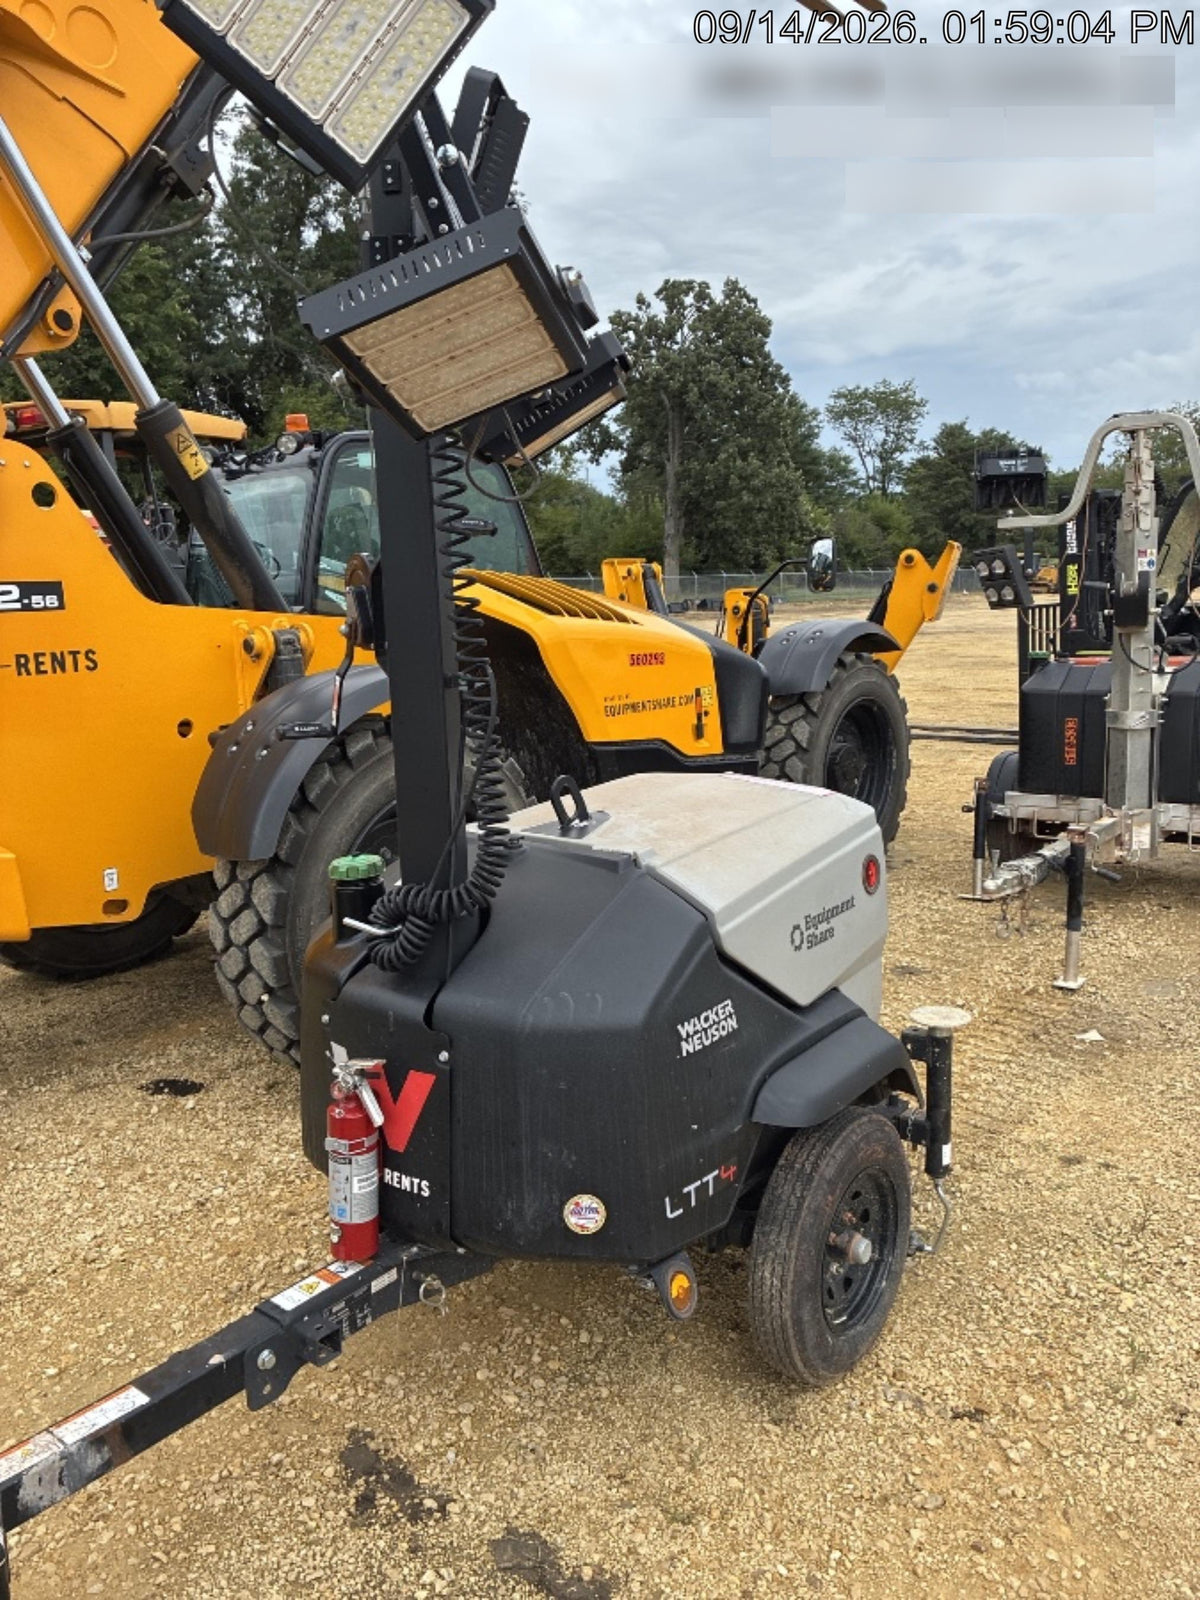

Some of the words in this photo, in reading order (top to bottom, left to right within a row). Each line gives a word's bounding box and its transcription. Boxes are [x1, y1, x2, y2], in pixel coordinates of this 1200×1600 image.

[804, 895, 856, 932] Equipment
[806, 926, 835, 950] Share
[677, 999, 735, 1039] WACKER
[680, 1013, 738, 1057] NEUSON
[383, 1167, 431, 1197] RENTS
[664, 1165, 738, 1219] LTT4
